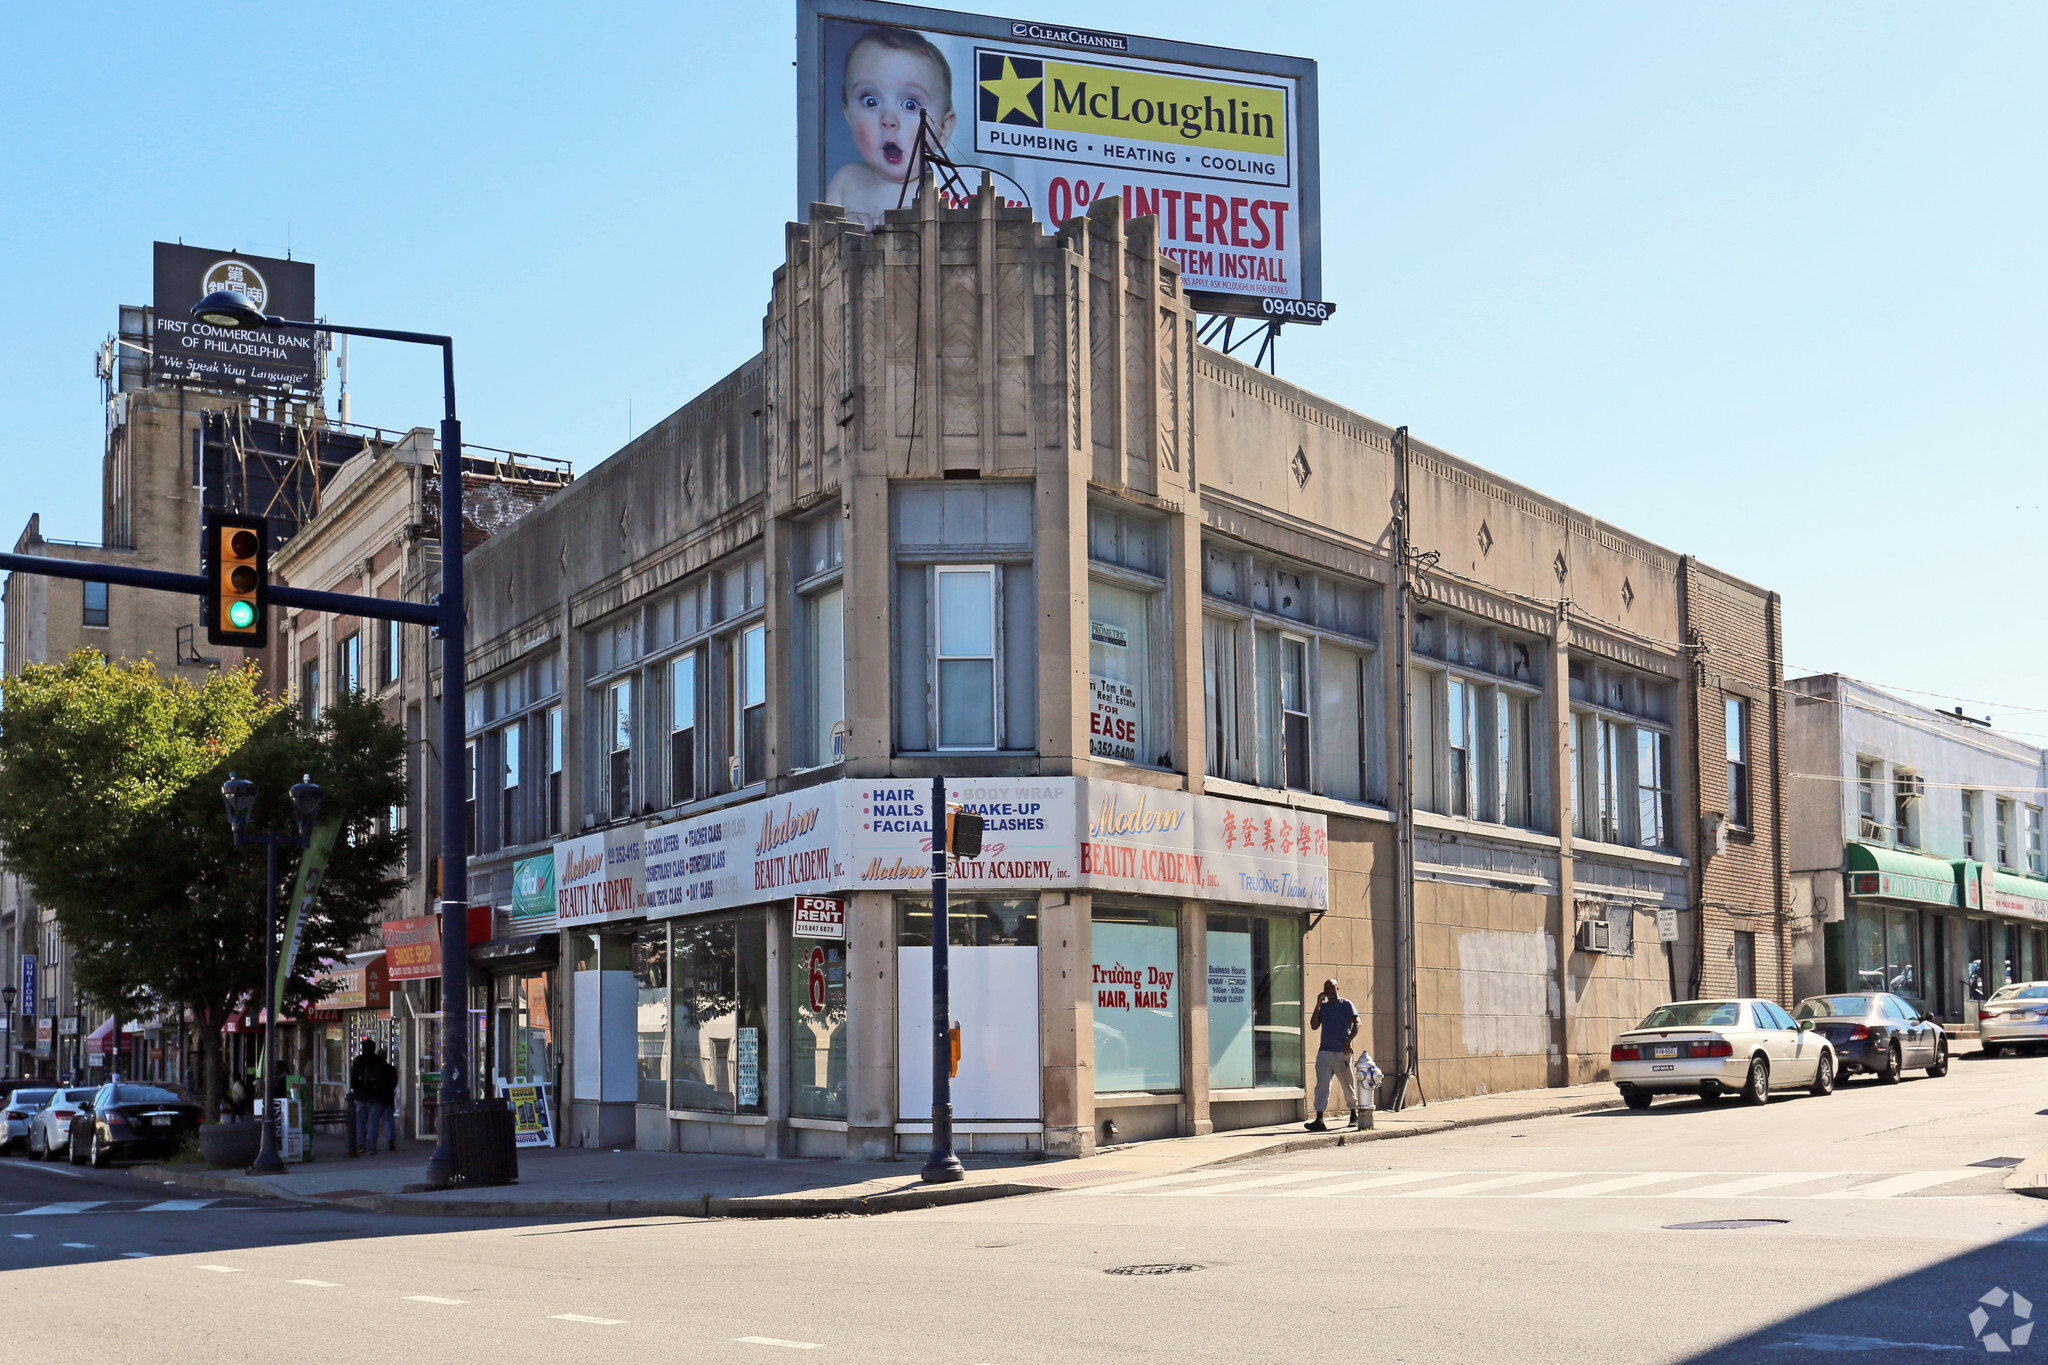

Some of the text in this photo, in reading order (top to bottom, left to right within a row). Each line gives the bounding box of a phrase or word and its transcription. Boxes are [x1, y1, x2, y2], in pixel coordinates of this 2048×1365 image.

[1053, 78, 1275, 138] McLoughlin
[990, 131, 1276, 176] PLUMBING HEATING COOLING
[1123, 184, 1289, 251] INTEREST
[1219, 252, 1287, 284] INSTALL
[1210, 281, 1222, 289] ASK
[1222, 282, 1256, 292] MCLOUGHLIN
[1256, 285, 1266, 293] FOR
[1268, 286, 1288, 295] DETAILS
[1262, 298, 1328, 319] 094056
[158, 318, 310, 348] FIRST COMMERCIAL BANK
[182, 336, 288, 360] OF PHILADELPHIA
[186, 358, 219, 373] Speak
[1092, 624, 1126, 640] PROMETRIC
[1097, 690, 1136, 708] Real Estate
[1101, 680, 1116, 694] Tom
[1120, 684, 1132, 698] Kim
[1098, 704, 1118, 714] FOR
[1090, 712, 1136, 743] EASE
[1090, 738, 1134, 760] 0-352-6400
[873, 789, 914, 802] HAIR
[964, 787, 1064, 800] BODY WRAP
[873, 804, 924, 816] NAILS
[964, 803, 1040, 816] MAKE-UP
[1089, 793, 1186, 838] Modern
[754, 801, 820, 857] Modern
[873, 820, 933, 832] FACIAL
[982, 818, 1044, 831] ELASHES
[648, 837, 664, 857] SCHOOL
[688, 824, 722, 848] TEACHER CLASS
[562, 845, 604, 886] Modern
[672, 858, 686, 878] CLASS
[712, 850, 726, 870] CLASS
[754, 856, 786, 890] BEAUTY
[787, 847, 832, 883] ACADEMY,
[834, 859, 845, 877] inc.
[860, 857, 1070, 880] Modern EAUTY ACADEMY, inc.
[1080, 842, 1220, 890] BEAUTY ACADEMY, inc.
[558, 884, 590, 919] BEAUTY
[592, 877, 636, 914] ACADEMY,
[669, 886, 682, 905] CLASS
[690, 882, 698, 902] DAY
[700, 880, 714, 900] CLASS
[1890, 876, 1936, 900] CONVENIENCE
[798, 909, 842, 922] RENT
[804, 898, 837, 911] FOR
[394, 944, 432, 966] SMOKE SHOP
[1148, 966, 1174, 990] Dạy
[1208, 965, 1230, 974] Business
[25, 964, 33, 1014] UNIFORMS
[369, 972, 380, 1000] ATM
[1098, 990, 1168, 1012] HAIR, NAILS
[308, 1007, 338, 1020] PIZZA
